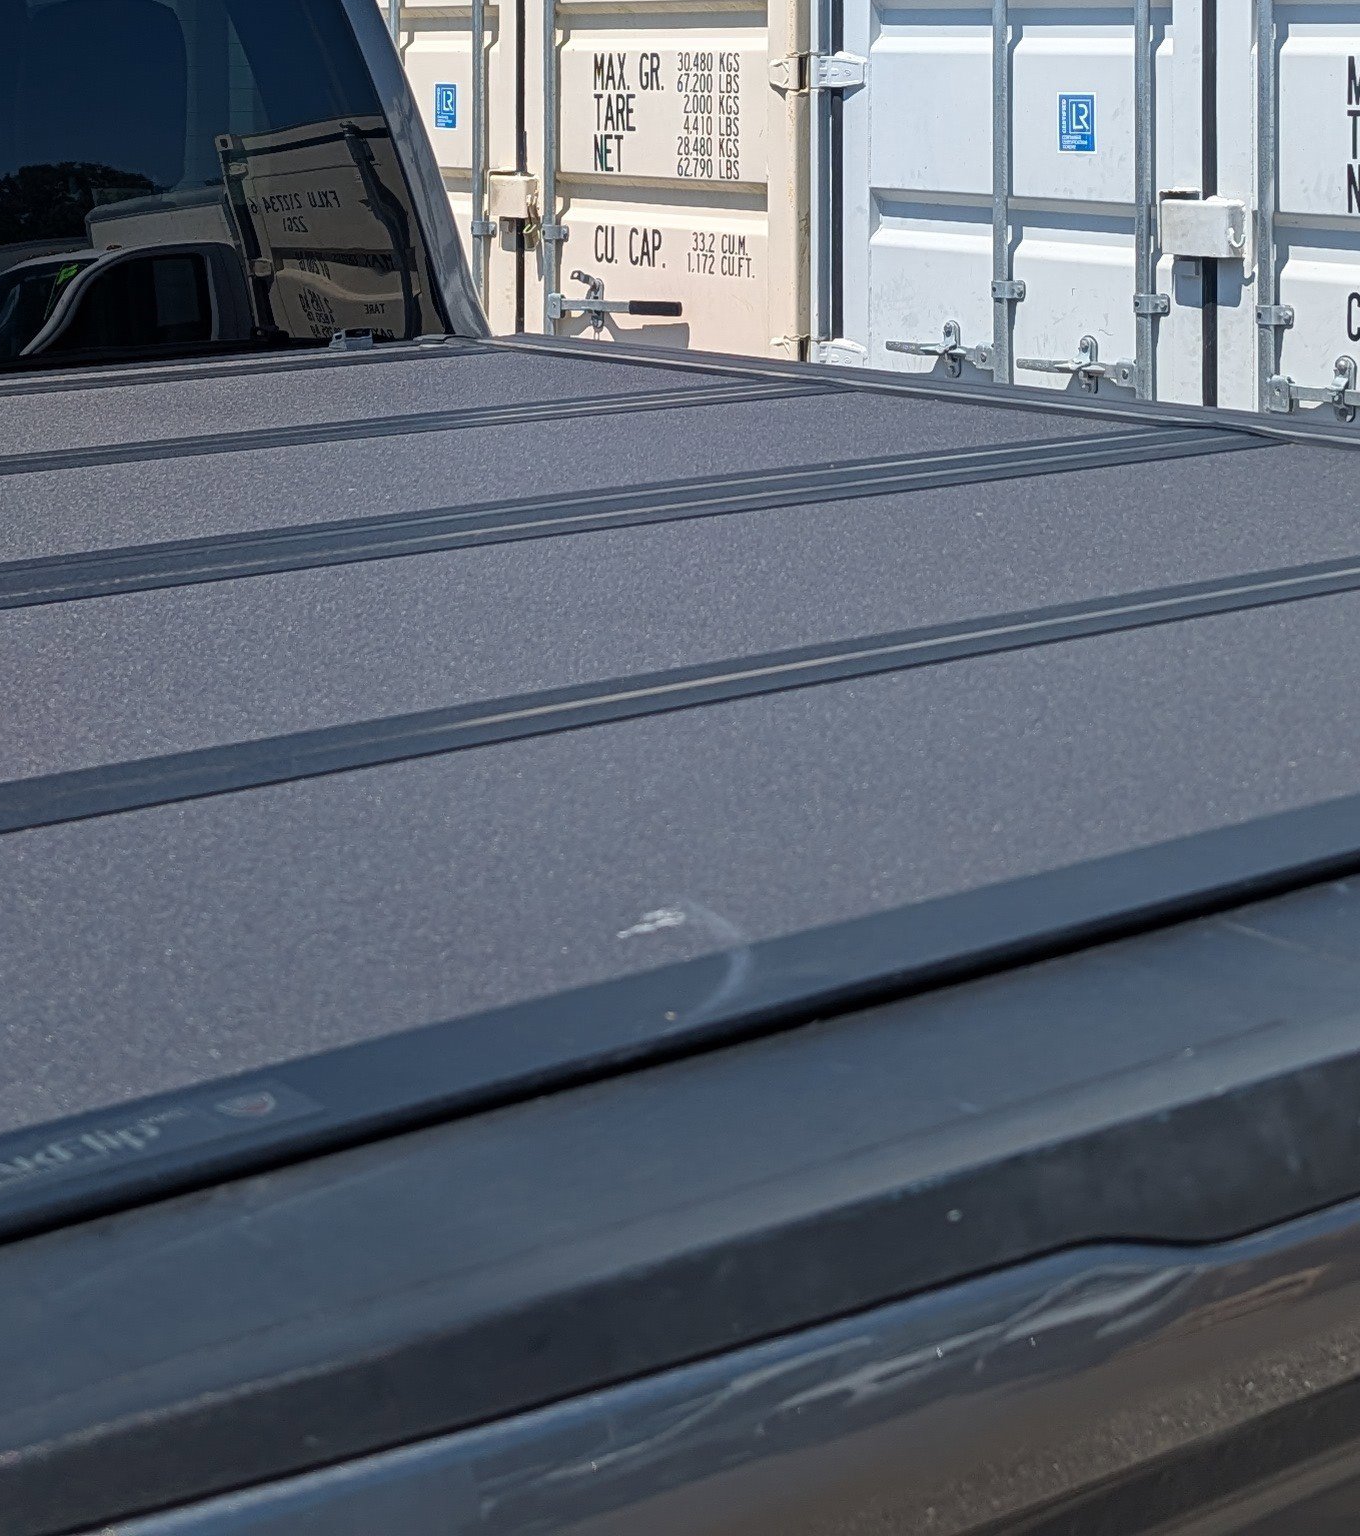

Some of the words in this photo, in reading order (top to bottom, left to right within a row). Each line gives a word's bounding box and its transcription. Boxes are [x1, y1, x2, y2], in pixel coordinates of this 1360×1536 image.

[593, 52, 630, 91] MAX.
[639, 52, 665, 91] GR.
[718, 52, 740, 73] KGS
[718, 73, 740, 94] LBS
[593, 93, 636, 132] TARE
[718, 95, 740, 115] KGS
[718, 116, 740, 137] LBS
[1072, 103, 1089, 130] LR
[593, 134, 624, 172] NET
[718, 138, 740, 158] KGS
[718, 159, 740, 180] LBS
[594, 224, 618, 264] CU.
[629, 227, 666, 269] CAP.
[692, 231, 715, 253] 33.2
